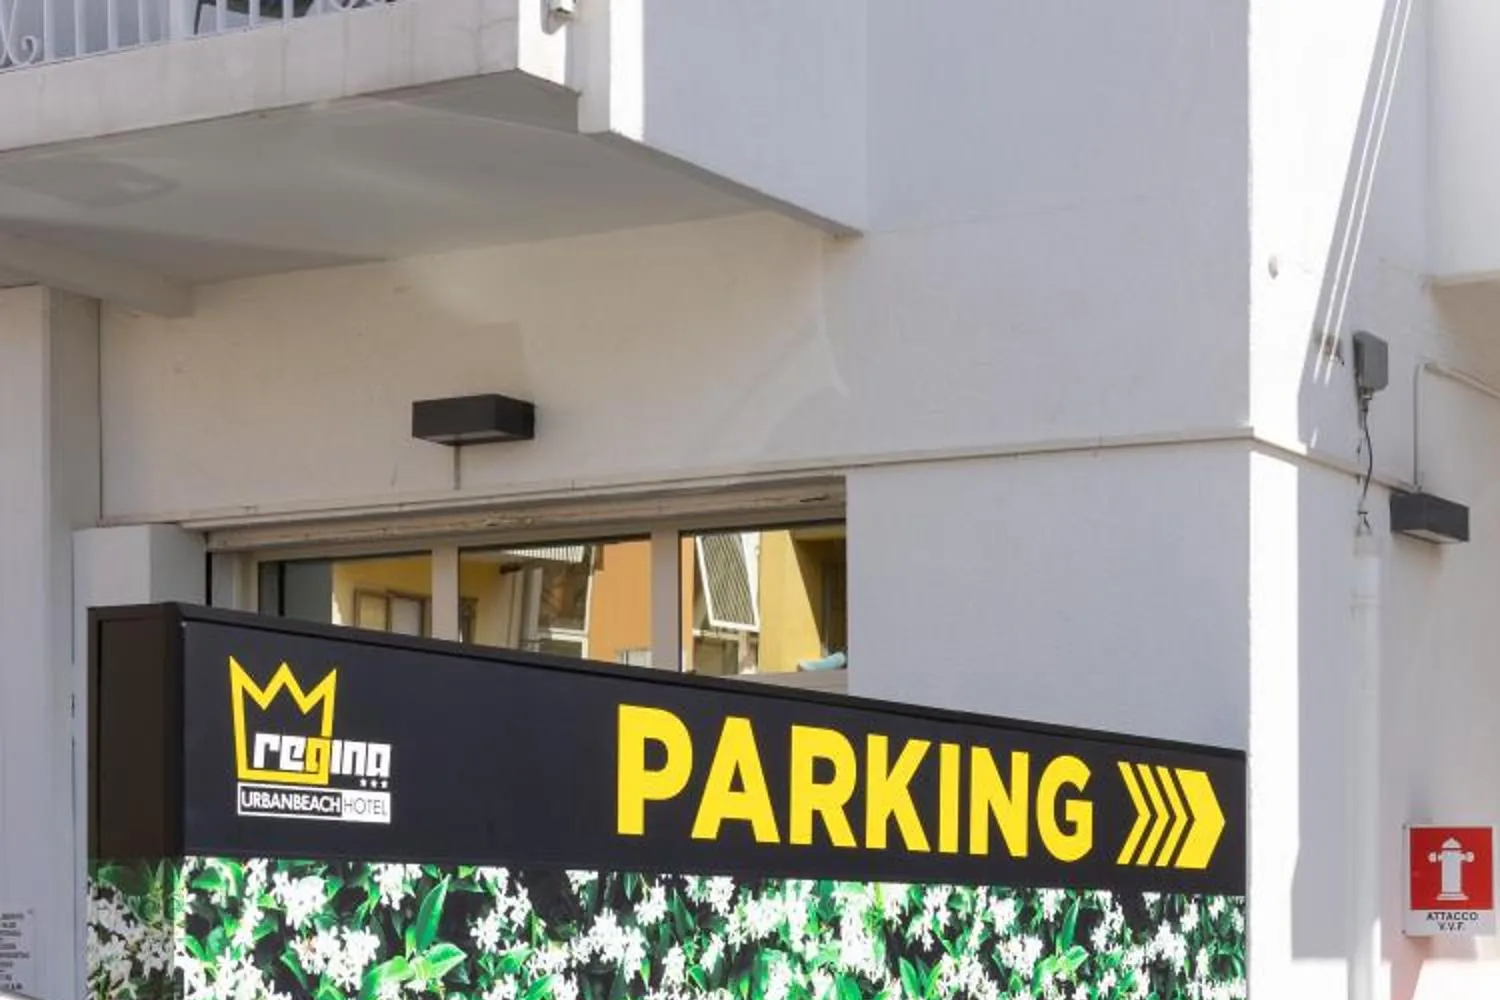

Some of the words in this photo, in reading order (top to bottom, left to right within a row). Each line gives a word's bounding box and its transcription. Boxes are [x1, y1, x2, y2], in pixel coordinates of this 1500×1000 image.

[617, 704, 1094, 862] PARKING
[344, 797, 388, 816] HOTEL
[1426, 911, 1478, 921] ATTACCO
